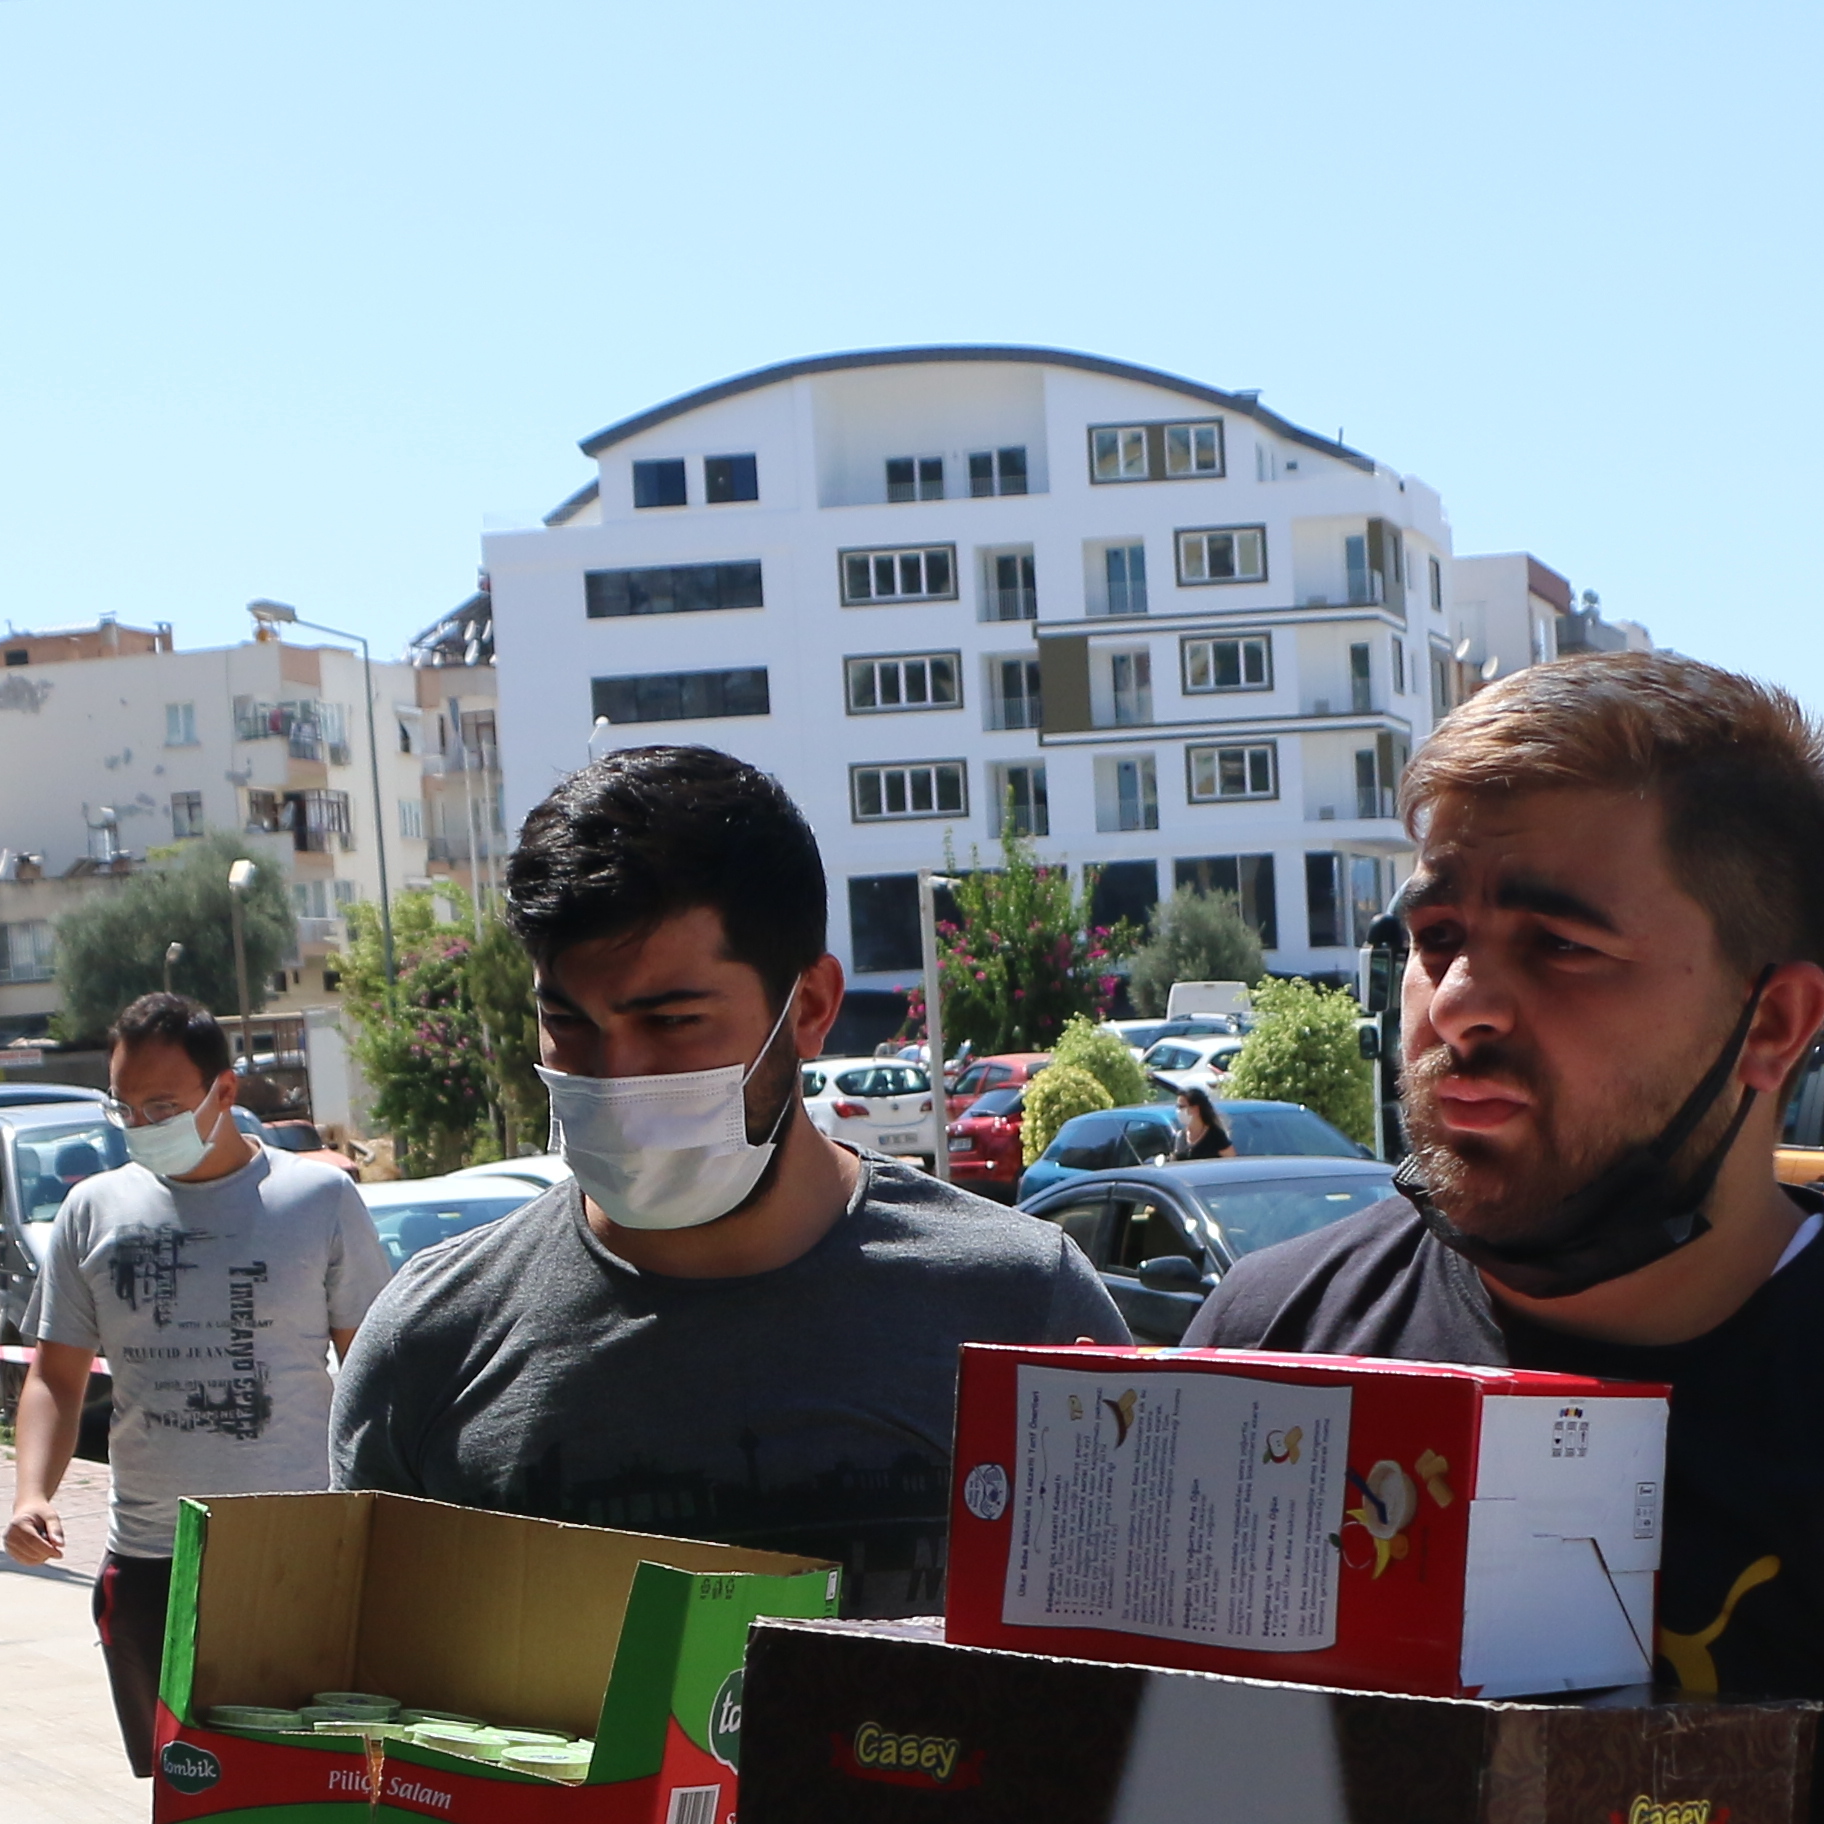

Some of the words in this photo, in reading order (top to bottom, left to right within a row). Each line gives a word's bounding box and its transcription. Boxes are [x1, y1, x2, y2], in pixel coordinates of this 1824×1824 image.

[1021, 1549, 1029, 1570] Bebe
[162, 1754, 217, 1779] tombik
[858, 1725, 959, 1779] Casey
[328, 1769, 374, 1793] Piliç
[387, 1776, 452, 1810] Salam
